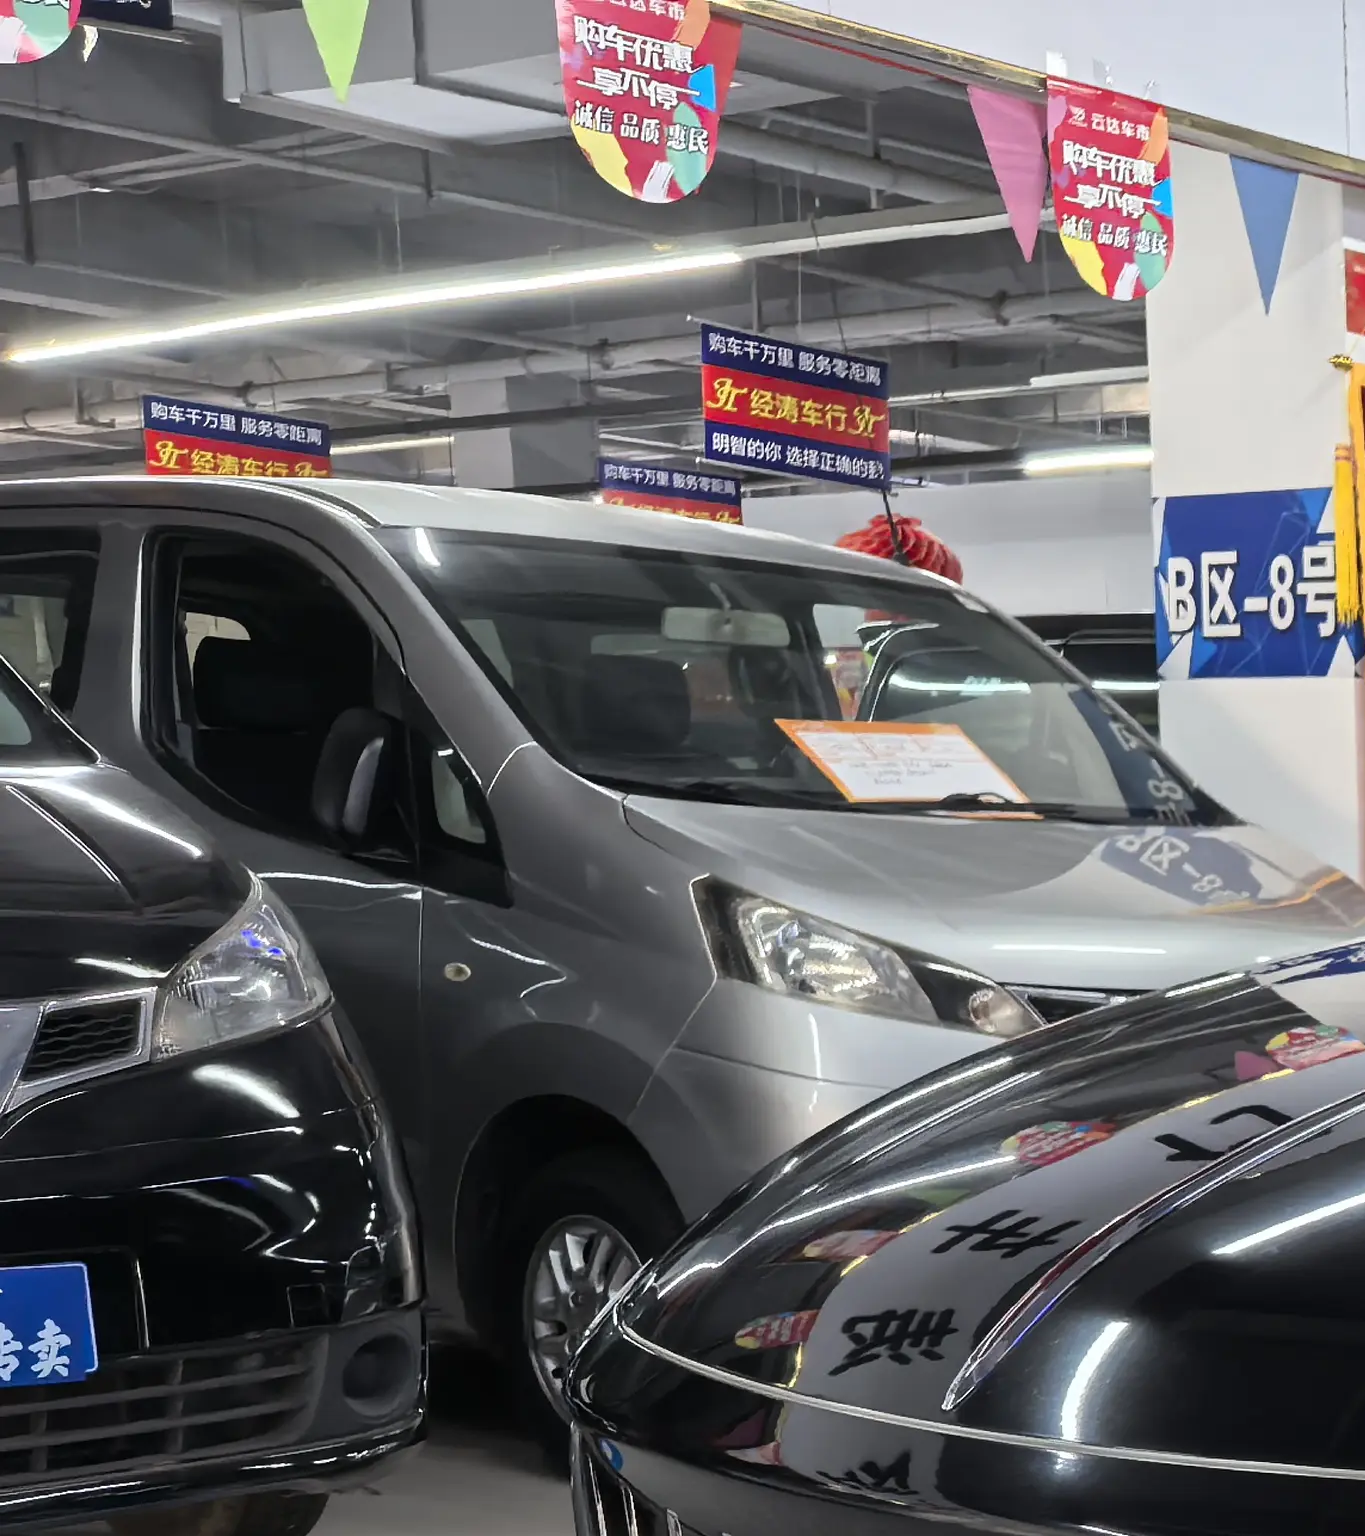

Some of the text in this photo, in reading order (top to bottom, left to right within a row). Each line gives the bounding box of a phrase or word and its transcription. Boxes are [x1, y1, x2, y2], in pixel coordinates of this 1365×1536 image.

[574, 16, 703, 73] 购车优惠
[577, 67, 700, 110] 享不停
[575, 100, 708, 153] 诚信 品质 惠民
[1063, 140, 1162, 186] 购车优惠
[1064, 183, 1160, 218] 享不停
[709, 332, 795, 369] 购车千万里
[151, 402, 236, 432] 购车千万里
[1167, 540, 1340, 638] B区-8号
